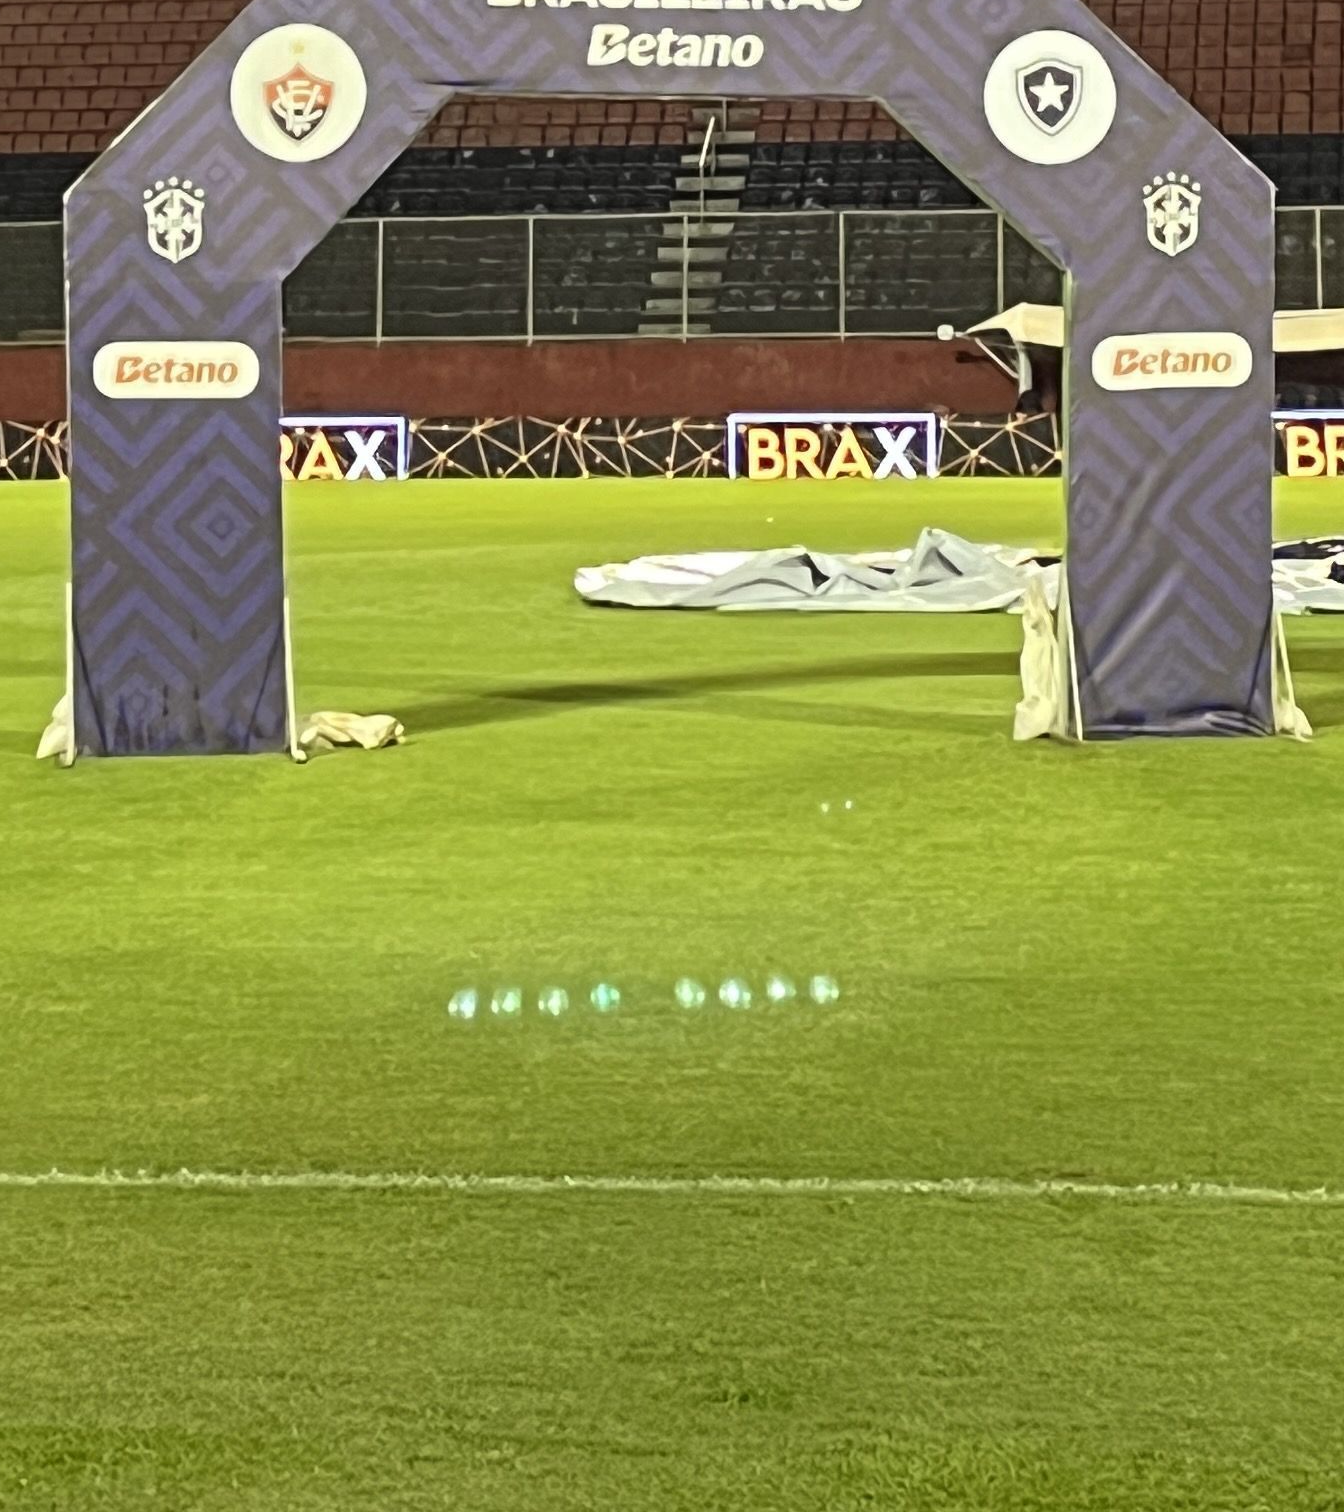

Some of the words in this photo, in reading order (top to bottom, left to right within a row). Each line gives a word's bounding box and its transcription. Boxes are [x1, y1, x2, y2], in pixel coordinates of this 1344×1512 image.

[587, 23, 764, 68] Betano
[115, 355, 239, 385] Betano
[1113, 348, 1233, 377] Betano
[748, 426, 918, 481] BRAX
